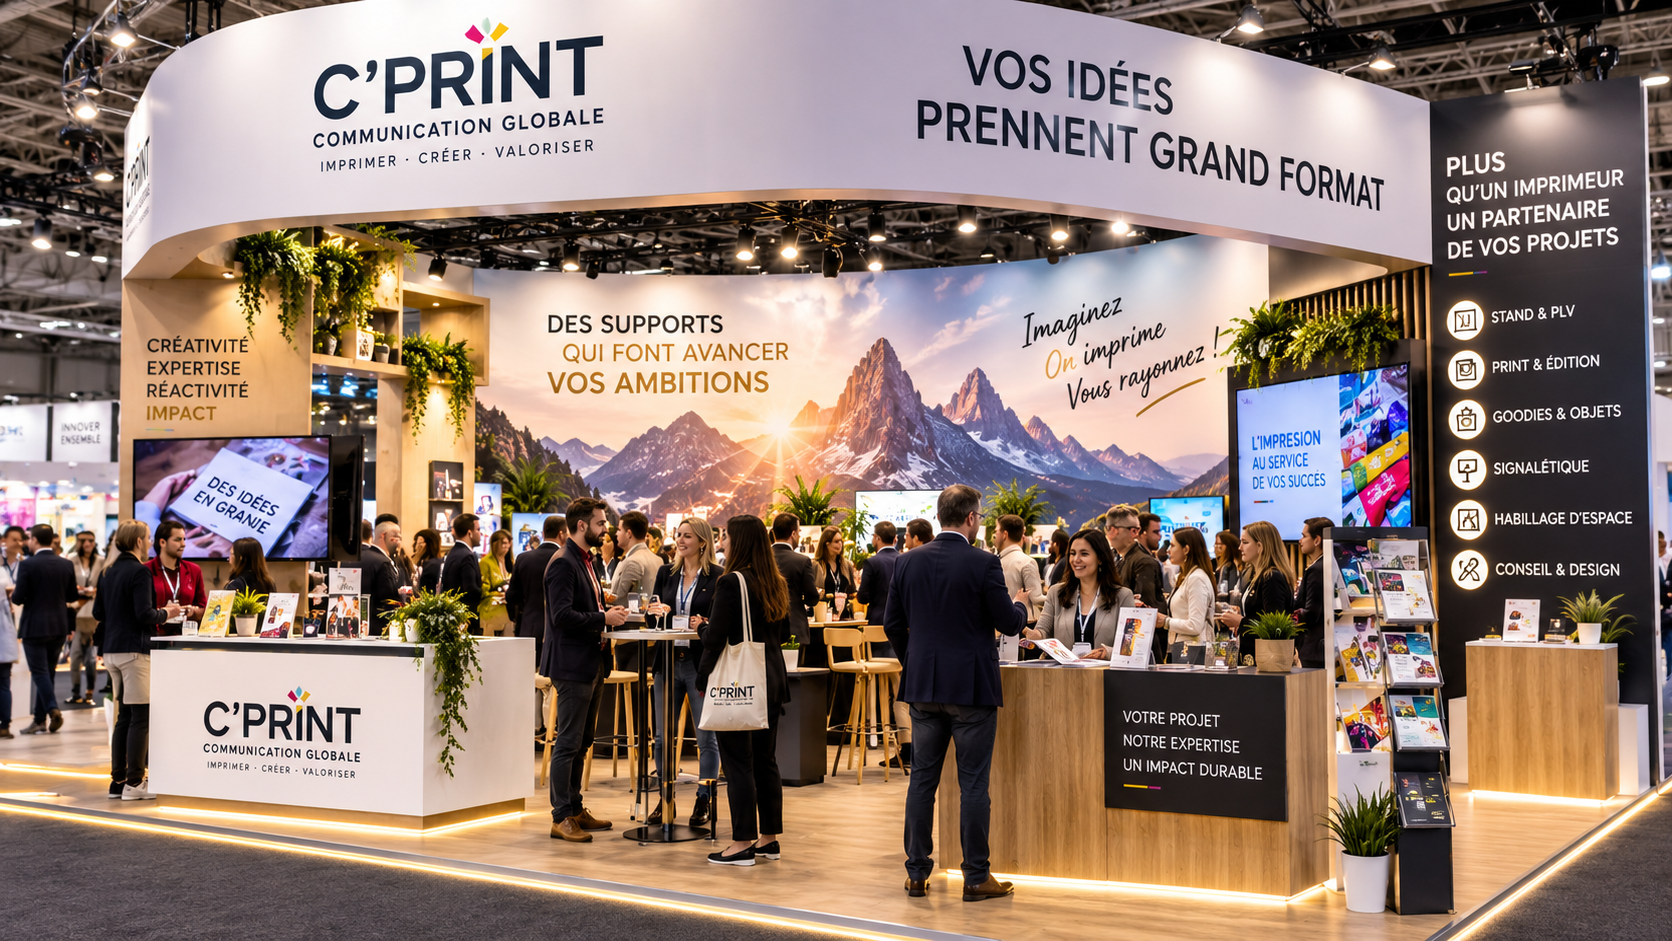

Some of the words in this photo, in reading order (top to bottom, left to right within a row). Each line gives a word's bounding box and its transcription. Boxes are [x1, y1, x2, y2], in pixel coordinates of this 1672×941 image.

[314, 35, 604, 120] C'PRINT
[963, 45, 1052, 94] VOS
[1067, 60, 1174, 115] IDÉES
[313, 117, 492, 148] COMMUNICATION
[502, 107, 604, 131] GLOBALE
[320, 155, 396, 172] IMPRIMER
[418, 147, 472, 164] CRÉER
[495, 139, 594, 158] VALORISER
[917, 100, 1138, 163] PRENNENT
[1149, 132, 1269, 187] GRAND
[1280, 157, 1385, 211] FORMAT
[1446, 151, 1506, 177] PLUS
[1446, 181, 1507, 205] QU'UN
[1514, 169, 1624, 197] IMPRIMEUR
[1447, 212, 1475, 231] UN
[1481, 198, 1610, 228] PARTENAIRE
[1447, 240, 1474, 260] DE
[1479, 236, 1521, 257] VOS
[1527, 227, 1619, 253] PROJETS
[548, 314, 593, 334] DES
[601, 314, 723, 334] SUPPORTS
[1022, 297, 1122, 349] Imaginez
[1491, 308, 1534, 324] STAND
[1537, 307, 1547, 320] &
[1551, 304, 1576, 319] PLV
[147, 335, 249, 353] CRÉATIVITÉ
[562, 343, 603, 364] QUI
[613, 343, 675, 362] FONT
[682, 342, 789, 362] AVANCER
[1045, 349, 1077, 379] On
[1083, 322, 1166, 369] imprime
[147, 361, 241, 375] EXPERTISE
[1067, 377, 1112, 410] Vous
[1119, 346, 1205, 399] rayonnez
[1213, 326, 1220, 358] !
[1492, 358, 1530, 373] PRINT
[1533, 358, 1543, 371] &
[1546, 354, 1600, 370] ÉDITION
[146, 380, 249, 398] RÉACTIVITÉ
[547, 371, 605, 394] VOS
[614, 370, 769, 394] AMBITIONS
[146, 405, 217, 421] IMPACT
[1493, 408, 1553, 423] GOODIES
[1556, 407, 1566, 420] &
[1570, 404, 1622, 419] OBJETS
[61, 421, 100, 432] INNOVER
[61, 434, 101, 445] ENSEMBLE
[1251, 430, 1321, 451] L'IMPRESION
[1252, 456, 1266, 470] AU
[1268, 452, 1309, 469] SERVICE
[1493, 459, 1590, 475] SIGNALÉTIQUE
[1252, 475, 1265, 490] DE
[1266, 474, 1286, 489] VOS
[193, 490, 216, 507] EN
[207, 476, 237, 498] DES
[236, 490, 279, 517] IDÉES
[1494, 512, 1566, 526] HABILLAGE
[1569, 511, 1633, 525] D'ESPACE
[1495, 562, 1552, 577] CONSEIL
[1555, 563, 1566, 576] &
[1569, 562, 1621, 577] DESIGN
[709, 685, 755, 698] C'PRINT
[203, 701, 361, 744] C'PRINT
[1122, 710, 1166, 725] VOTRE
[1170, 712, 1220, 728] PROJET
[203, 743, 301, 759] COMMUNICATION
[306, 748, 361, 763] GLOBALE
[1123, 734, 1167, 749] NOTRE
[1171, 736, 1240, 754] EXPERTISE
[207, 761, 250, 771] IMPRIMER
[261, 763, 291, 774] CRÉER
[302, 767, 356, 779] VALORISER
[1123, 758, 1142, 772] UN
[1146, 760, 1195, 776] IMPACT
[1199, 763, 1263, 781] DURABLE
